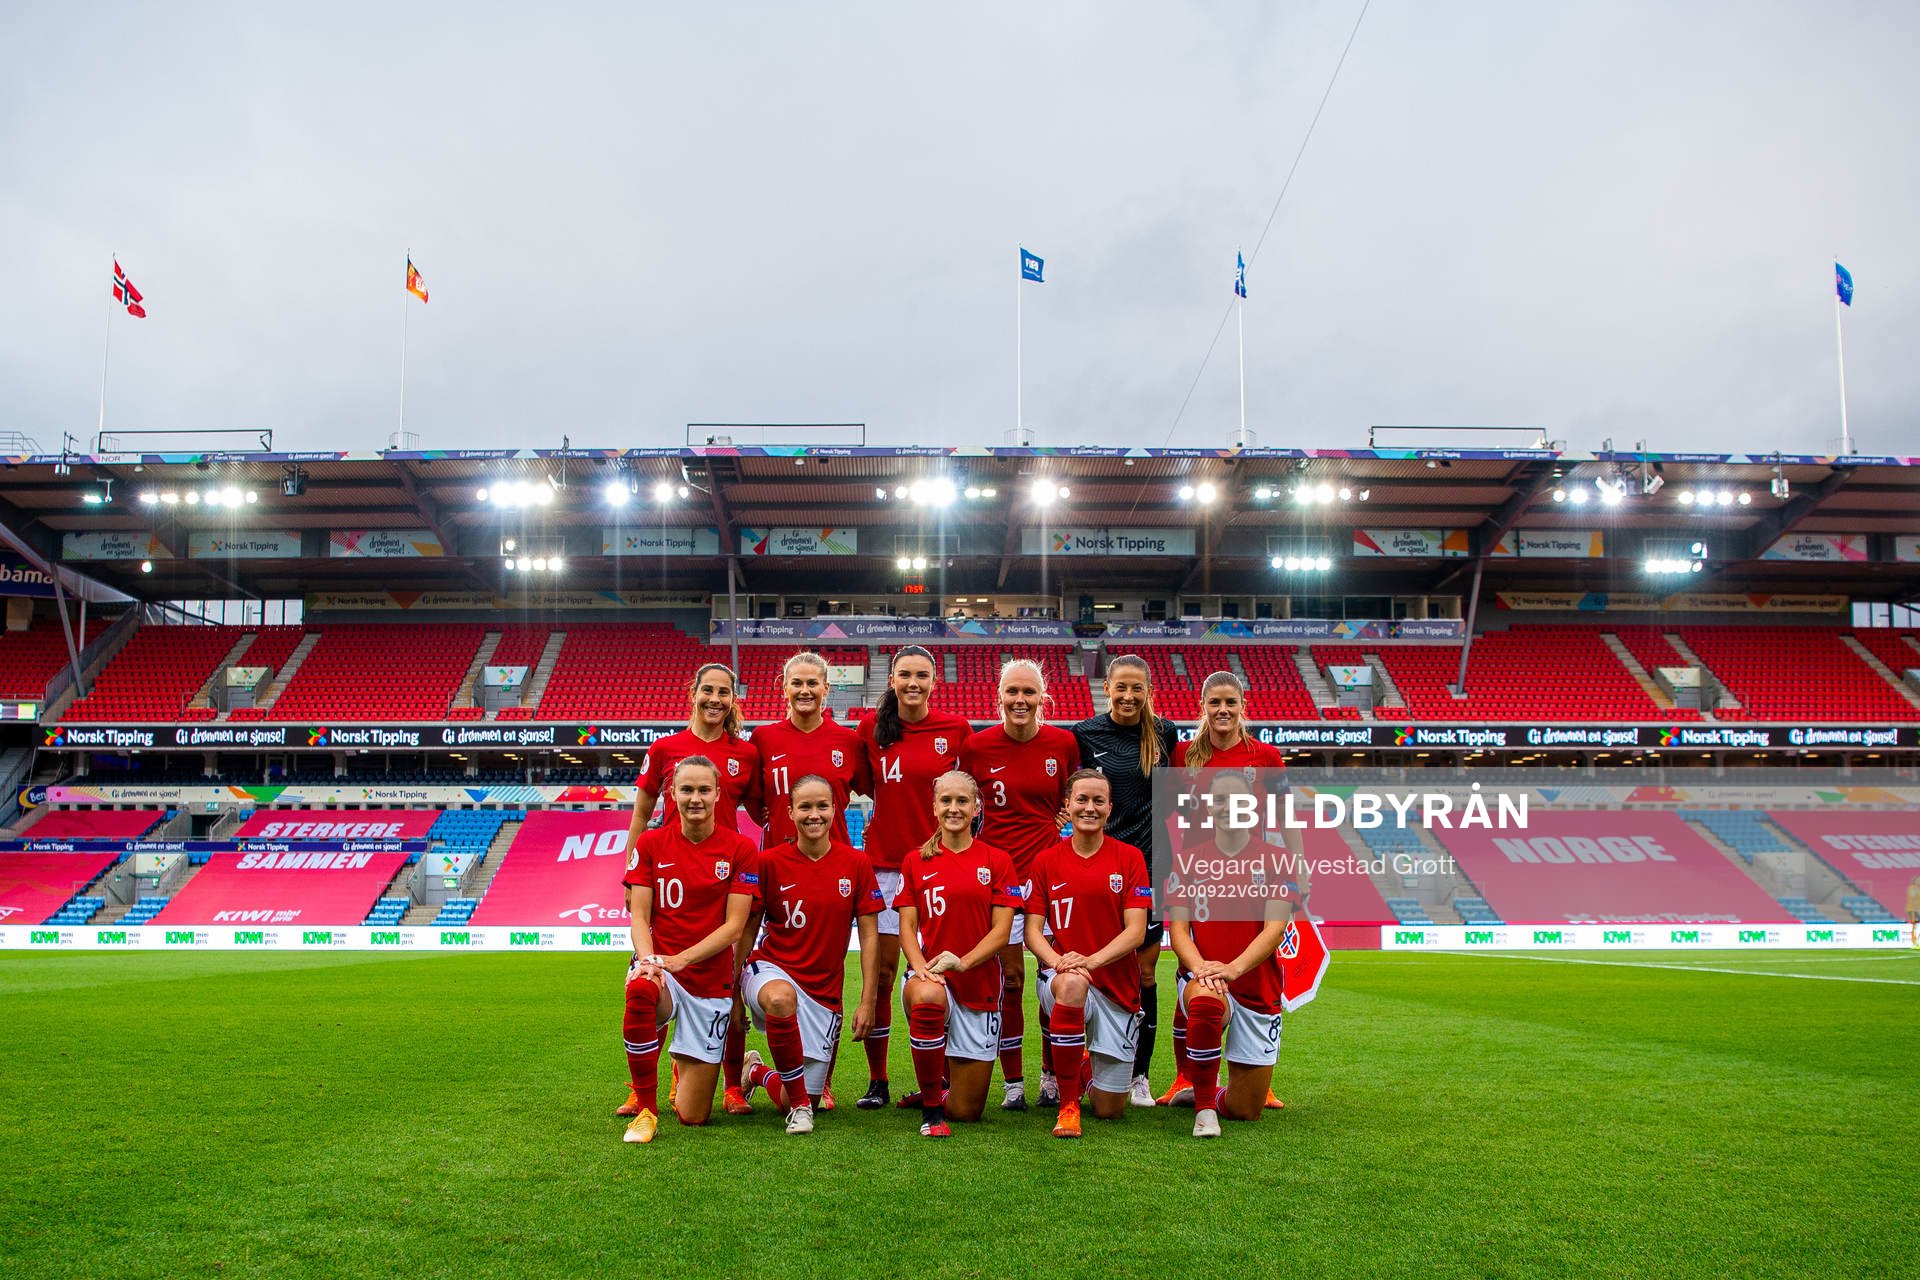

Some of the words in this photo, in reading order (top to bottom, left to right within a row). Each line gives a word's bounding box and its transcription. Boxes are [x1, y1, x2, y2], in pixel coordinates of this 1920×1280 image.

[225, 541, 247, 550] Norsk
[249, 541, 279, 551] Tipping
[640, 538, 663, 547] Norsk
[665, 538, 695, 549] Tipping
[1076, 538, 1114, 549] Norsk
[1116, 537, 1165, 551] Tipping
[1527, 540, 1550, 549] Norsk
[1552, 540, 1581, 551] Tipping
[743, 626, 765, 634] Norsk
[766, 626, 793, 636] Tipping
[1008, 626, 1030, 634] Norsk
[1031, 626, 1058, 636] Tipping
[1140, 626, 1162, 634] Norsk
[1163, 626, 1190, 636] Tipping
[1403, 627, 1425, 635] Norsk
[1425, 627, 1452, 637] Tipping
[67, 729, 104, 743] Norsk
[106, 729, 154, 747] Tipping
[176, 728, 188, 744] Gi
[235, 731, 248, 744] en
[250, 728, 285, 745] sjanse!
[331, 729, 369, 743] Norsk
[371, 729, 419, 746] Tipping
[443, 727, 455, 743] Gi
[503, 730, 517, 743] en
[518, 727, 554, 745] sjanse!
[601, 729, 639, 742] Norsk
[1260, 728, 1273, 744] Gi
[1321, 730, 1334, 744] en
[1335, 728, 1372, 746] sjanse!
[1417, 730, 1456, 743] Norsk
[1457, 729, 1506, 746] Tipping
[1527, 728, 1541, 744] Gi
[1588, 731, 1601, 744] en
[1602, 728, 1639, 746] sjanse!
[1681, 730, 1720, 744] Norsk
[1721, 730, 1769, 746] Tipping
[1789, 729, 1803, 745] Gi
[1849, 731, 1862, 745] en
[1863, 729, 1898, 747] sjanse!
[880, 756, 903, 783] 14
[772, 767, 789, 795] 11
[112, 788, 118, 798] Gi
[159, 788, 181, 800] sjanse!
[375, 789, 398, 799] Norsk
[399, 789, 427, 801] Tipping
[993, 781, 1006, 807] 3
[258, 822, 405, 839] STERKERE
[33, 843, 50, 851] Norsk
[51, 843, 73, 852] Tipping
[247, 843, 265, 851] Norsk
[266, 843, 288, 852] Tipping
[1491, 836, 1677, 864] NORGE
[236, 852, 374, 870] SAMMEN
[657, 878, 684, 909] 10
[924, 886, 946, 918] 15
[1194, 891, 1210, 923] 8
[213, 910, 273, 921] KIWI
[783, 900, 807, 929] 16
[1052, 897, 1074, 930] 17
[31, 931, 59, 944] KIWI
[98, 931, 126, 944] KIWI
[166, 931, 194, 944] KIWI
[234, 931, 263, 944] KIWI
[303, 932, 332, 944] KIWI
[371, 932, 400, 944] KIWI
[441, 932, 470, 944] KIWI
[510, 932, 539, 944] KIWI
[581, 932, 611, 944] KIWI
[708, 1010, 730, 1041] 10
[1268, 1016, 1281, 1043] 8
